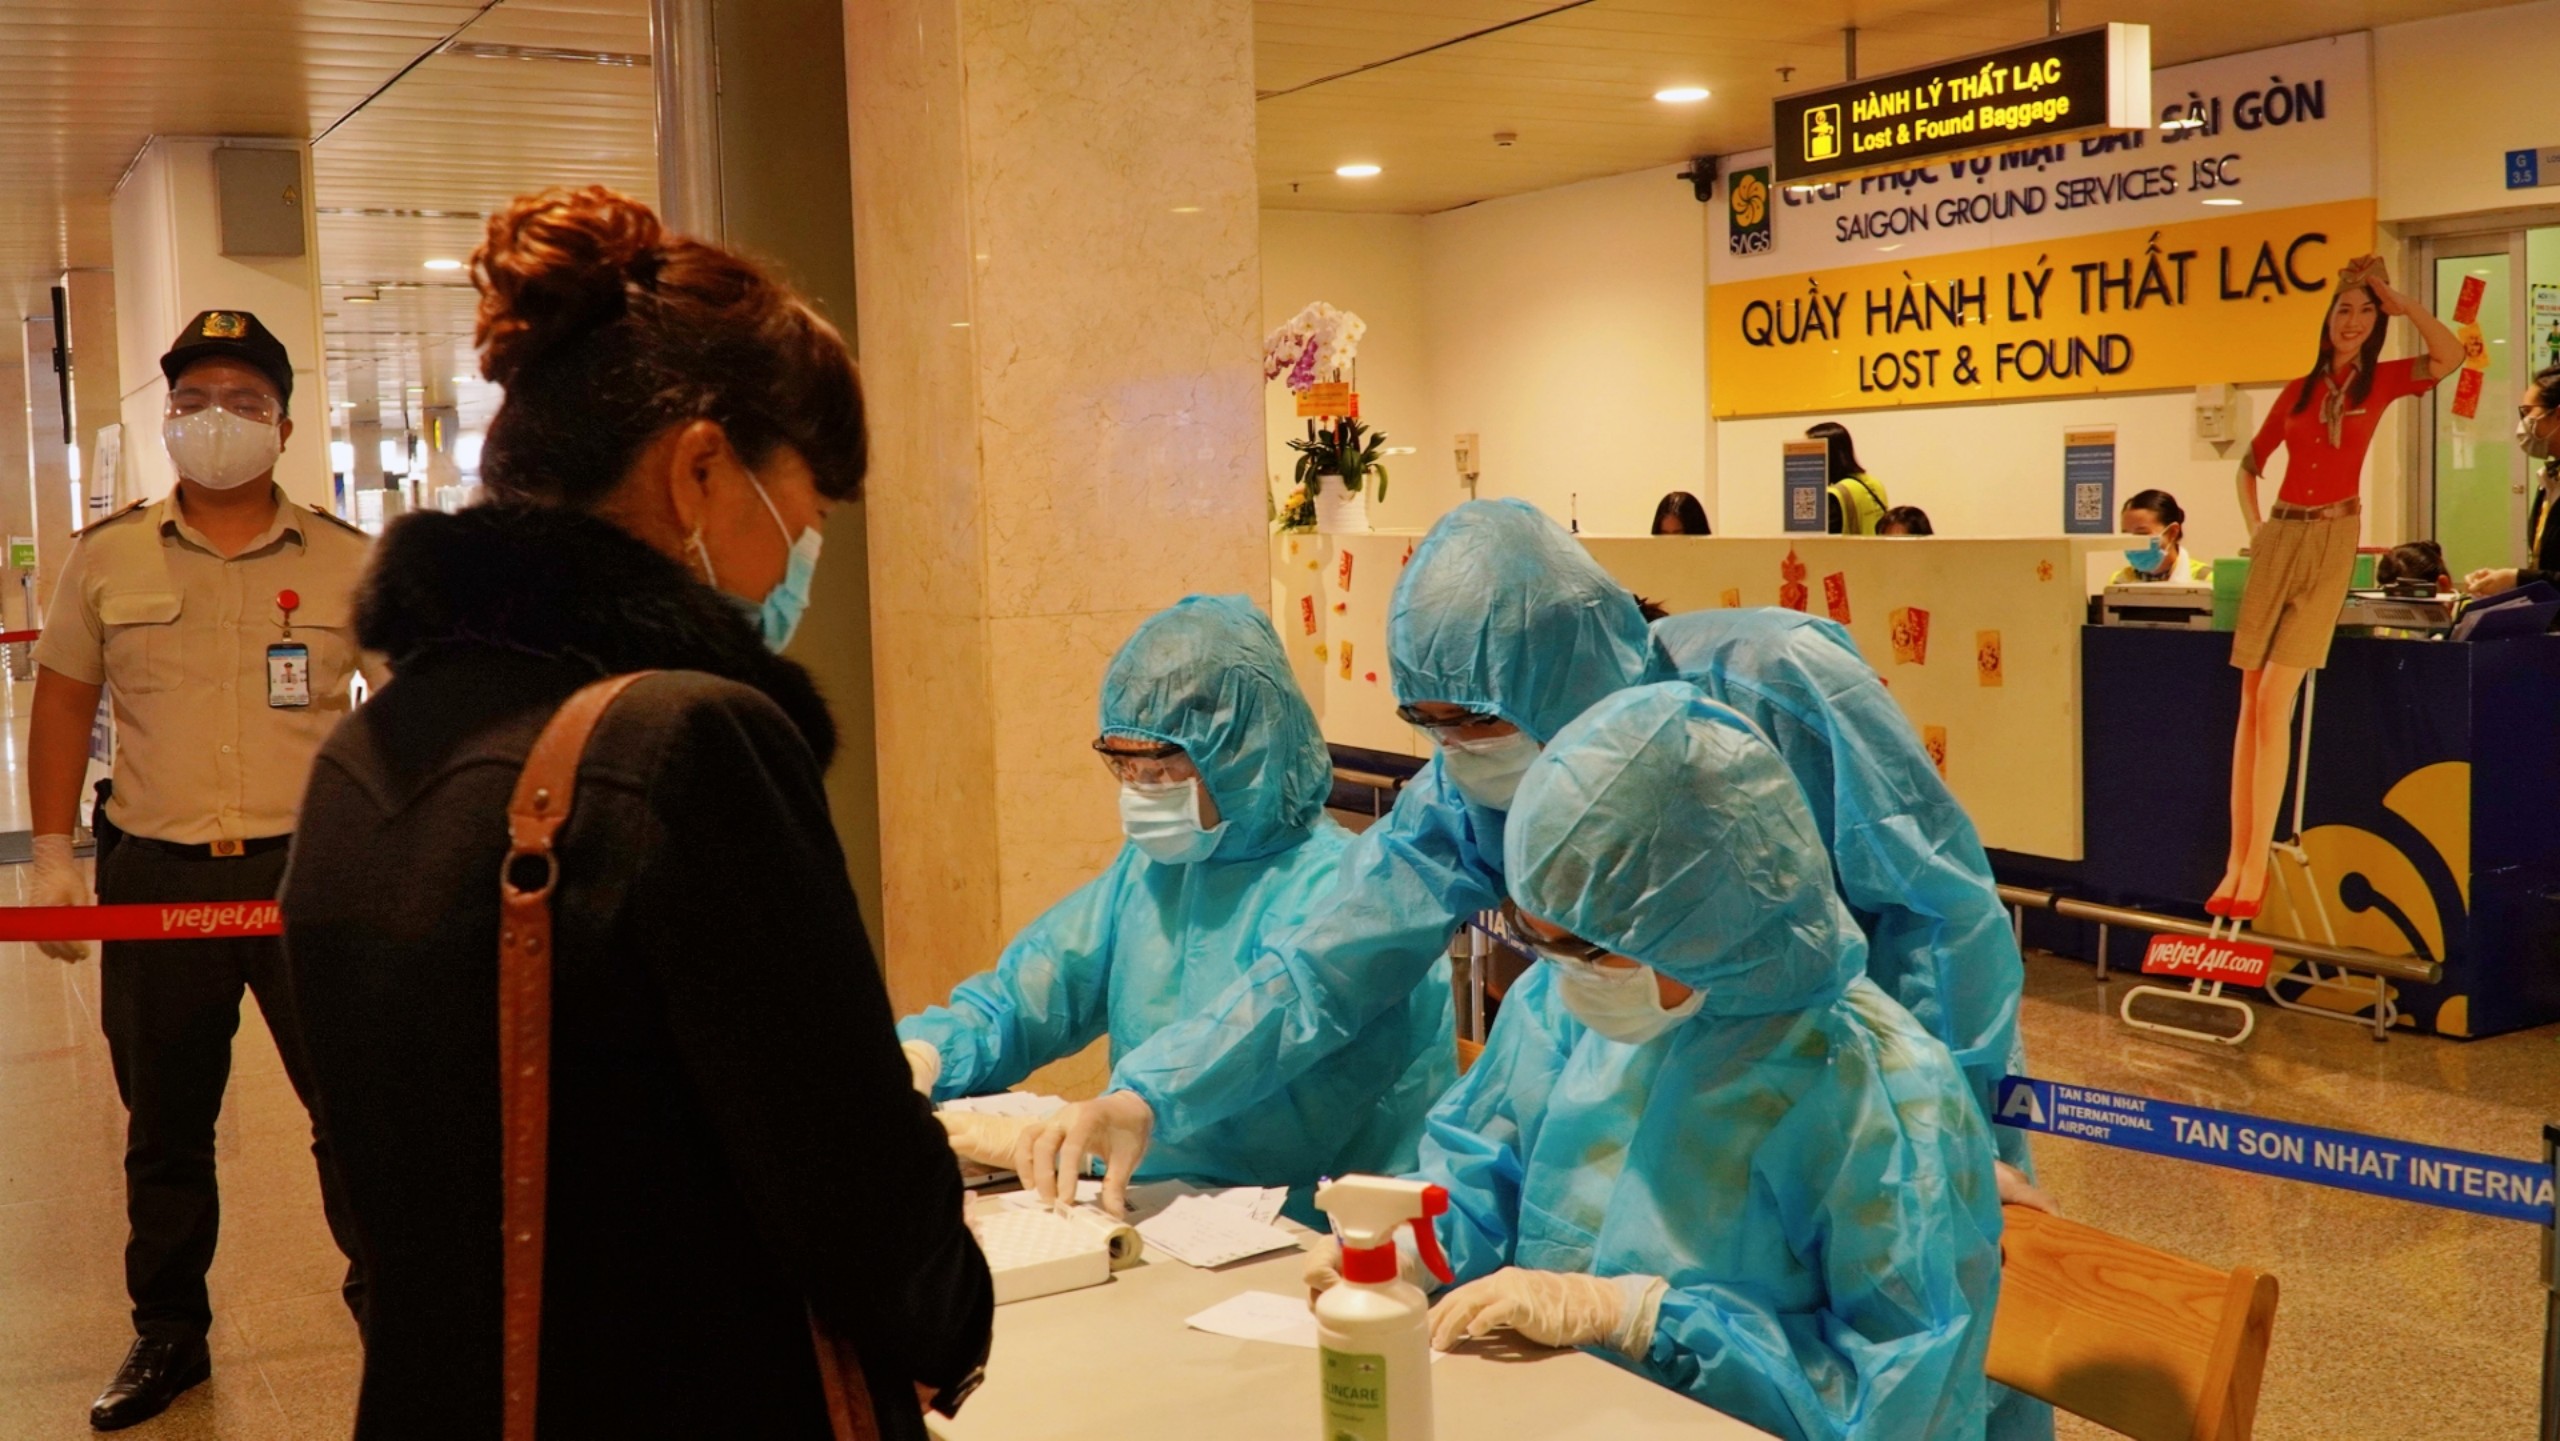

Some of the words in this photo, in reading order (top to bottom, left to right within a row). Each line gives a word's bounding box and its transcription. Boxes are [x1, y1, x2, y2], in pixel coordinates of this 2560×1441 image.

[1852, 88, 1910, 123] HÀNH
[1916, 77, 1943, 111] LÝ
[1948, 61, 2008, 104] THẤT
[2013, 57, 2062, 92] LẠC
[2159, 91, 2221, 143] SÀI
[2233, 76, 2326, 131] GÒN
[1853, 123, 1893, 153] Lost
[1896, 122, 1911, 145] &
[1915, 107, 1975, 140] Found
[1979, 94, 2071, 130] Baggage
[2512, 170, 2533, 183] 3.5
[2516, 154, 2527, 168] G
[1836, 204, 1930, 243] SAIGON
[1935, 186, 2047, 229] GROUND
[2055, 164, 2176, 210] SERVICES
[2188, 154, 2242, 192] JSC
[1730, 230, 1771, 257] SAGS
[1741, 277, 1848, 347] QUẦY
[1865, 269, 1987, 336] HÀNH
[2007, 254, 2054, 321] LÝ
[2071, 231, 2198, 314] THẤT
[2219, 233, 2328, 303] LẠC
[1859, 349, 1942, 392] LOST
[1953, 345, 1981, 385] &
[1996, 333, 2134, 383] FOUND
[2057, 1087, 2082, 1101] TAN
[2084, 1090, 2110, 1105] SON
[2113, 1095, 2147, 1112] NHAT
[2057, 1103, 2154, 1132] INTERNATIONAL
[2057, 1120, 2111, 1139] AIRPORT
[2170, 1115, 2229, 1151] TAN
[2237, 1128, 2303, 1165] SON
[2314, 1141, 2400, 1181] NHAT
[1324, 1381, 1379, 1401] LINCARE
